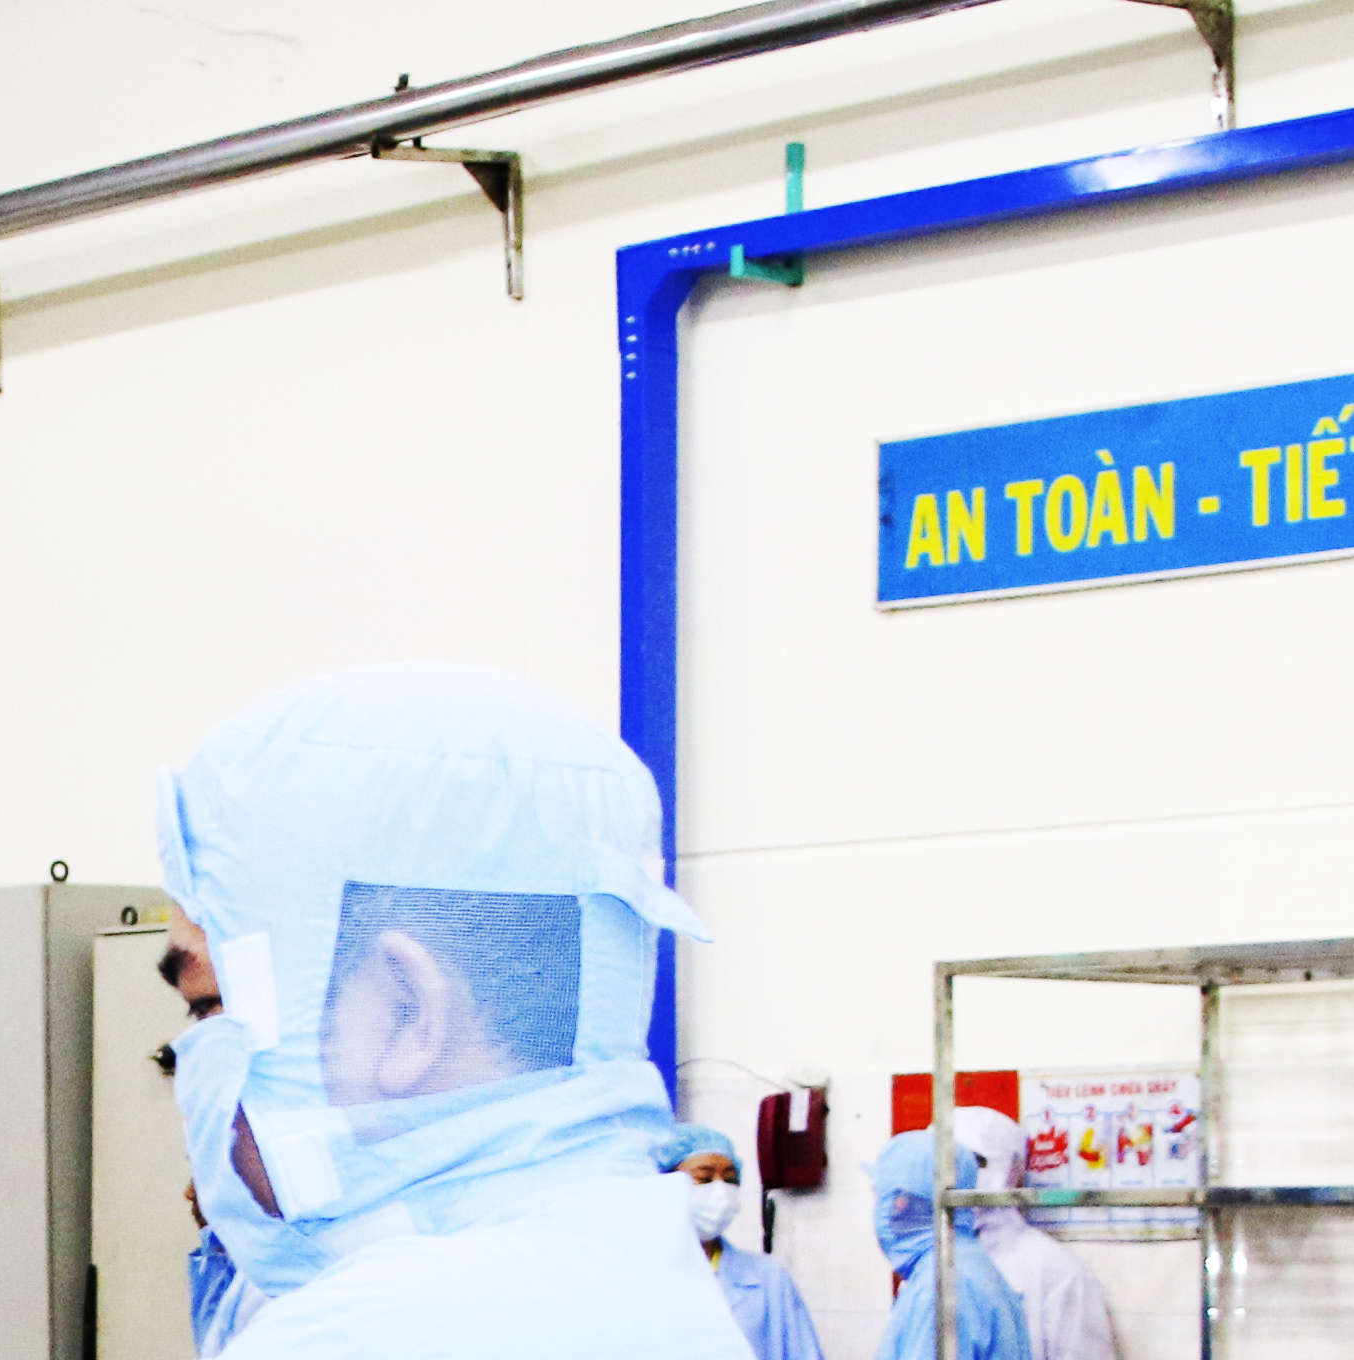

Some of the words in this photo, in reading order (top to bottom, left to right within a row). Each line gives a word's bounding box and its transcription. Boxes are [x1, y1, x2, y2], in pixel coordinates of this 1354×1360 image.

[905, 487, 985, 568] AN
[1005, 449, 1174, 555] TOÀN
[1240, 403, 1354, 526] TIẾ
